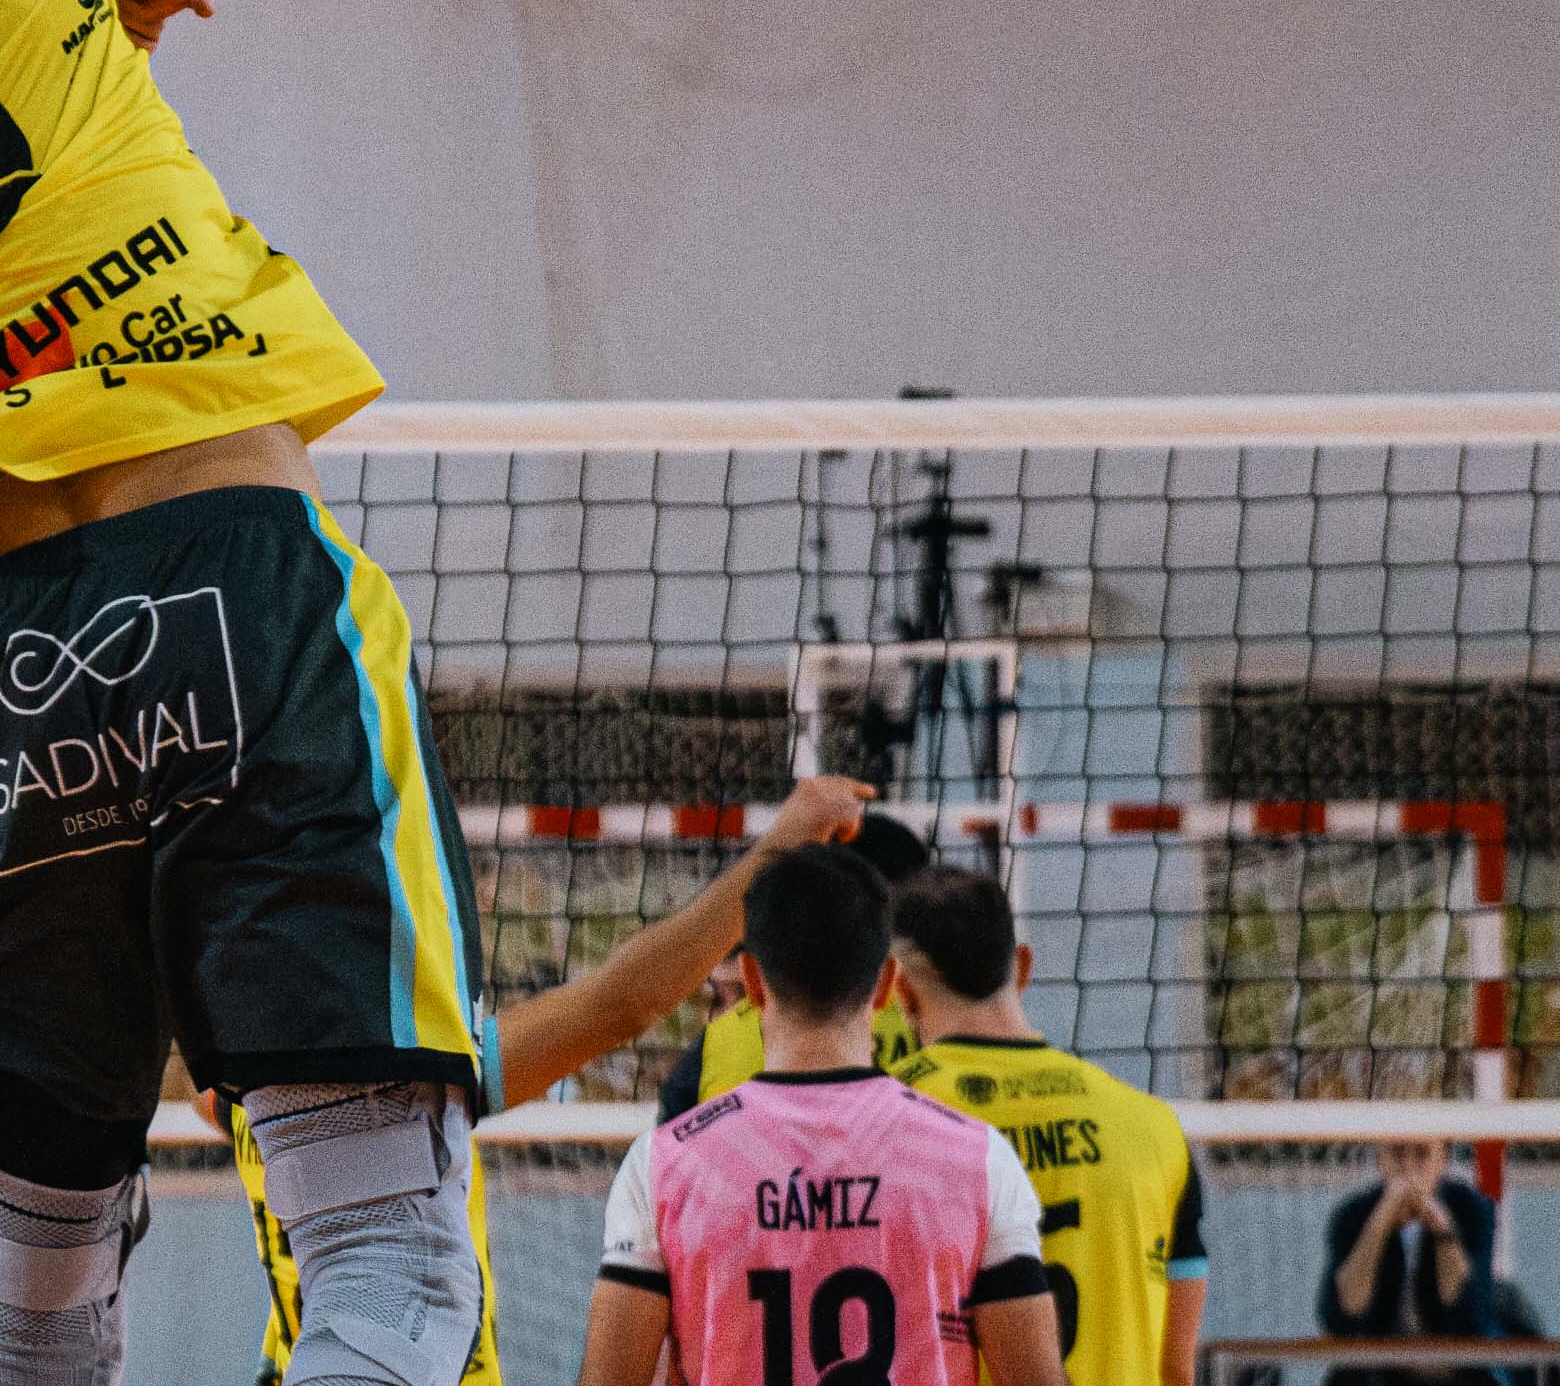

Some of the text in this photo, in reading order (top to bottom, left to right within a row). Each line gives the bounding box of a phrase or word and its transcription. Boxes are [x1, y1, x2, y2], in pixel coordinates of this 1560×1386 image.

[120, 293, 184, 348] Car
[61, 804, 128, 837] DESDE
[756, 1165, 880, 1231] GÁMIZ
